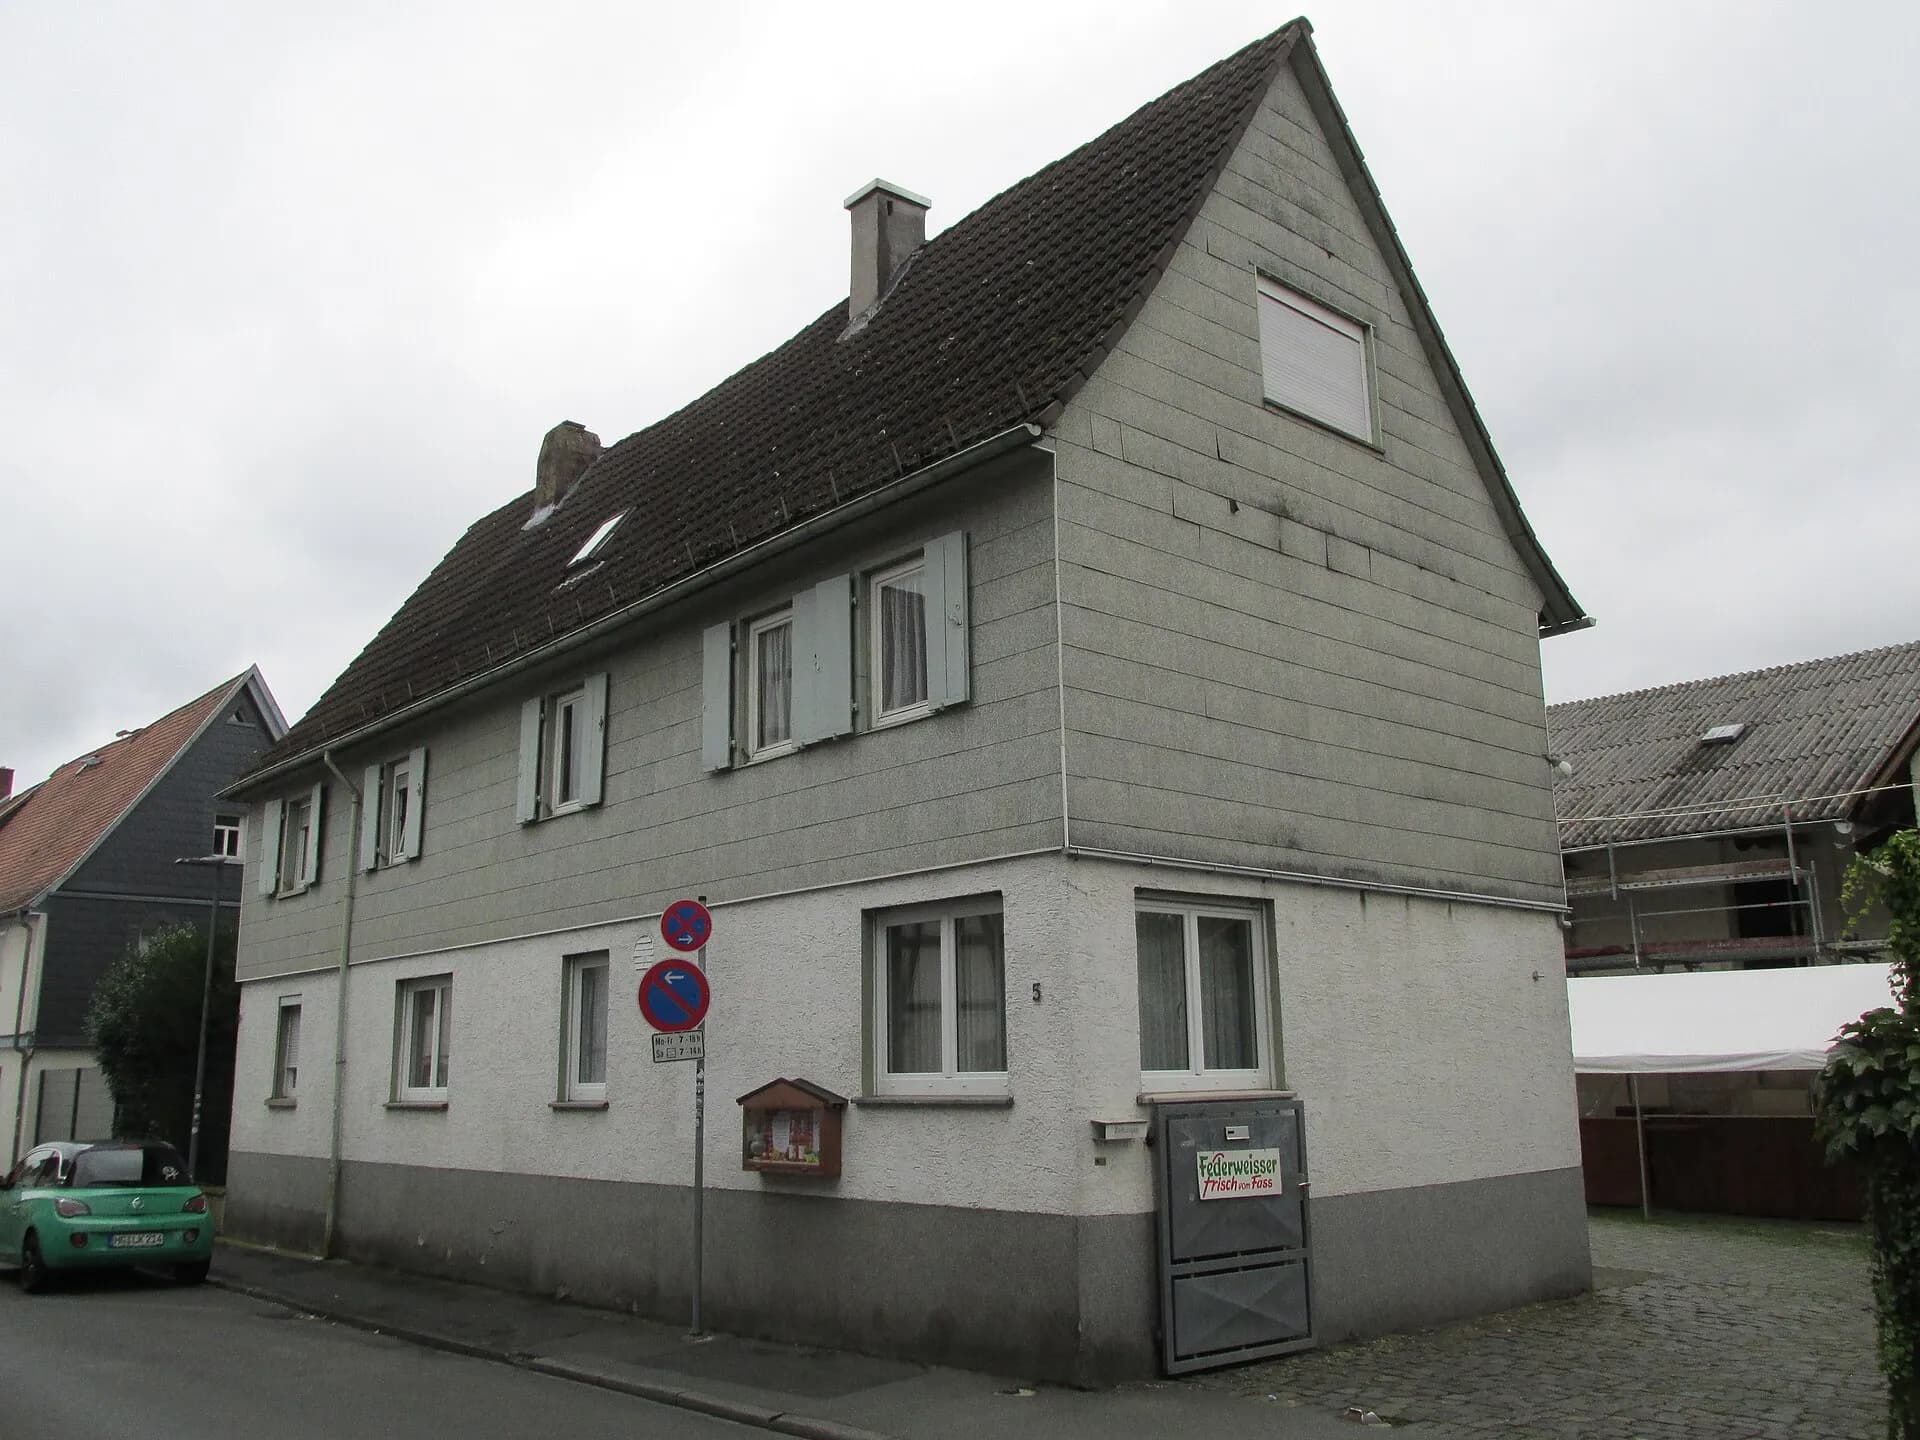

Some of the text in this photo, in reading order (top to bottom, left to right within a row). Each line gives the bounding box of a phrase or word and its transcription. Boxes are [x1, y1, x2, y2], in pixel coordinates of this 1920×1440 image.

[1032, 982, 1041, 1002] 5
[1199, 1153, 1277, 1177] Federweisser
[1202, 1175, 1273, 1198] frisch vom Fass
